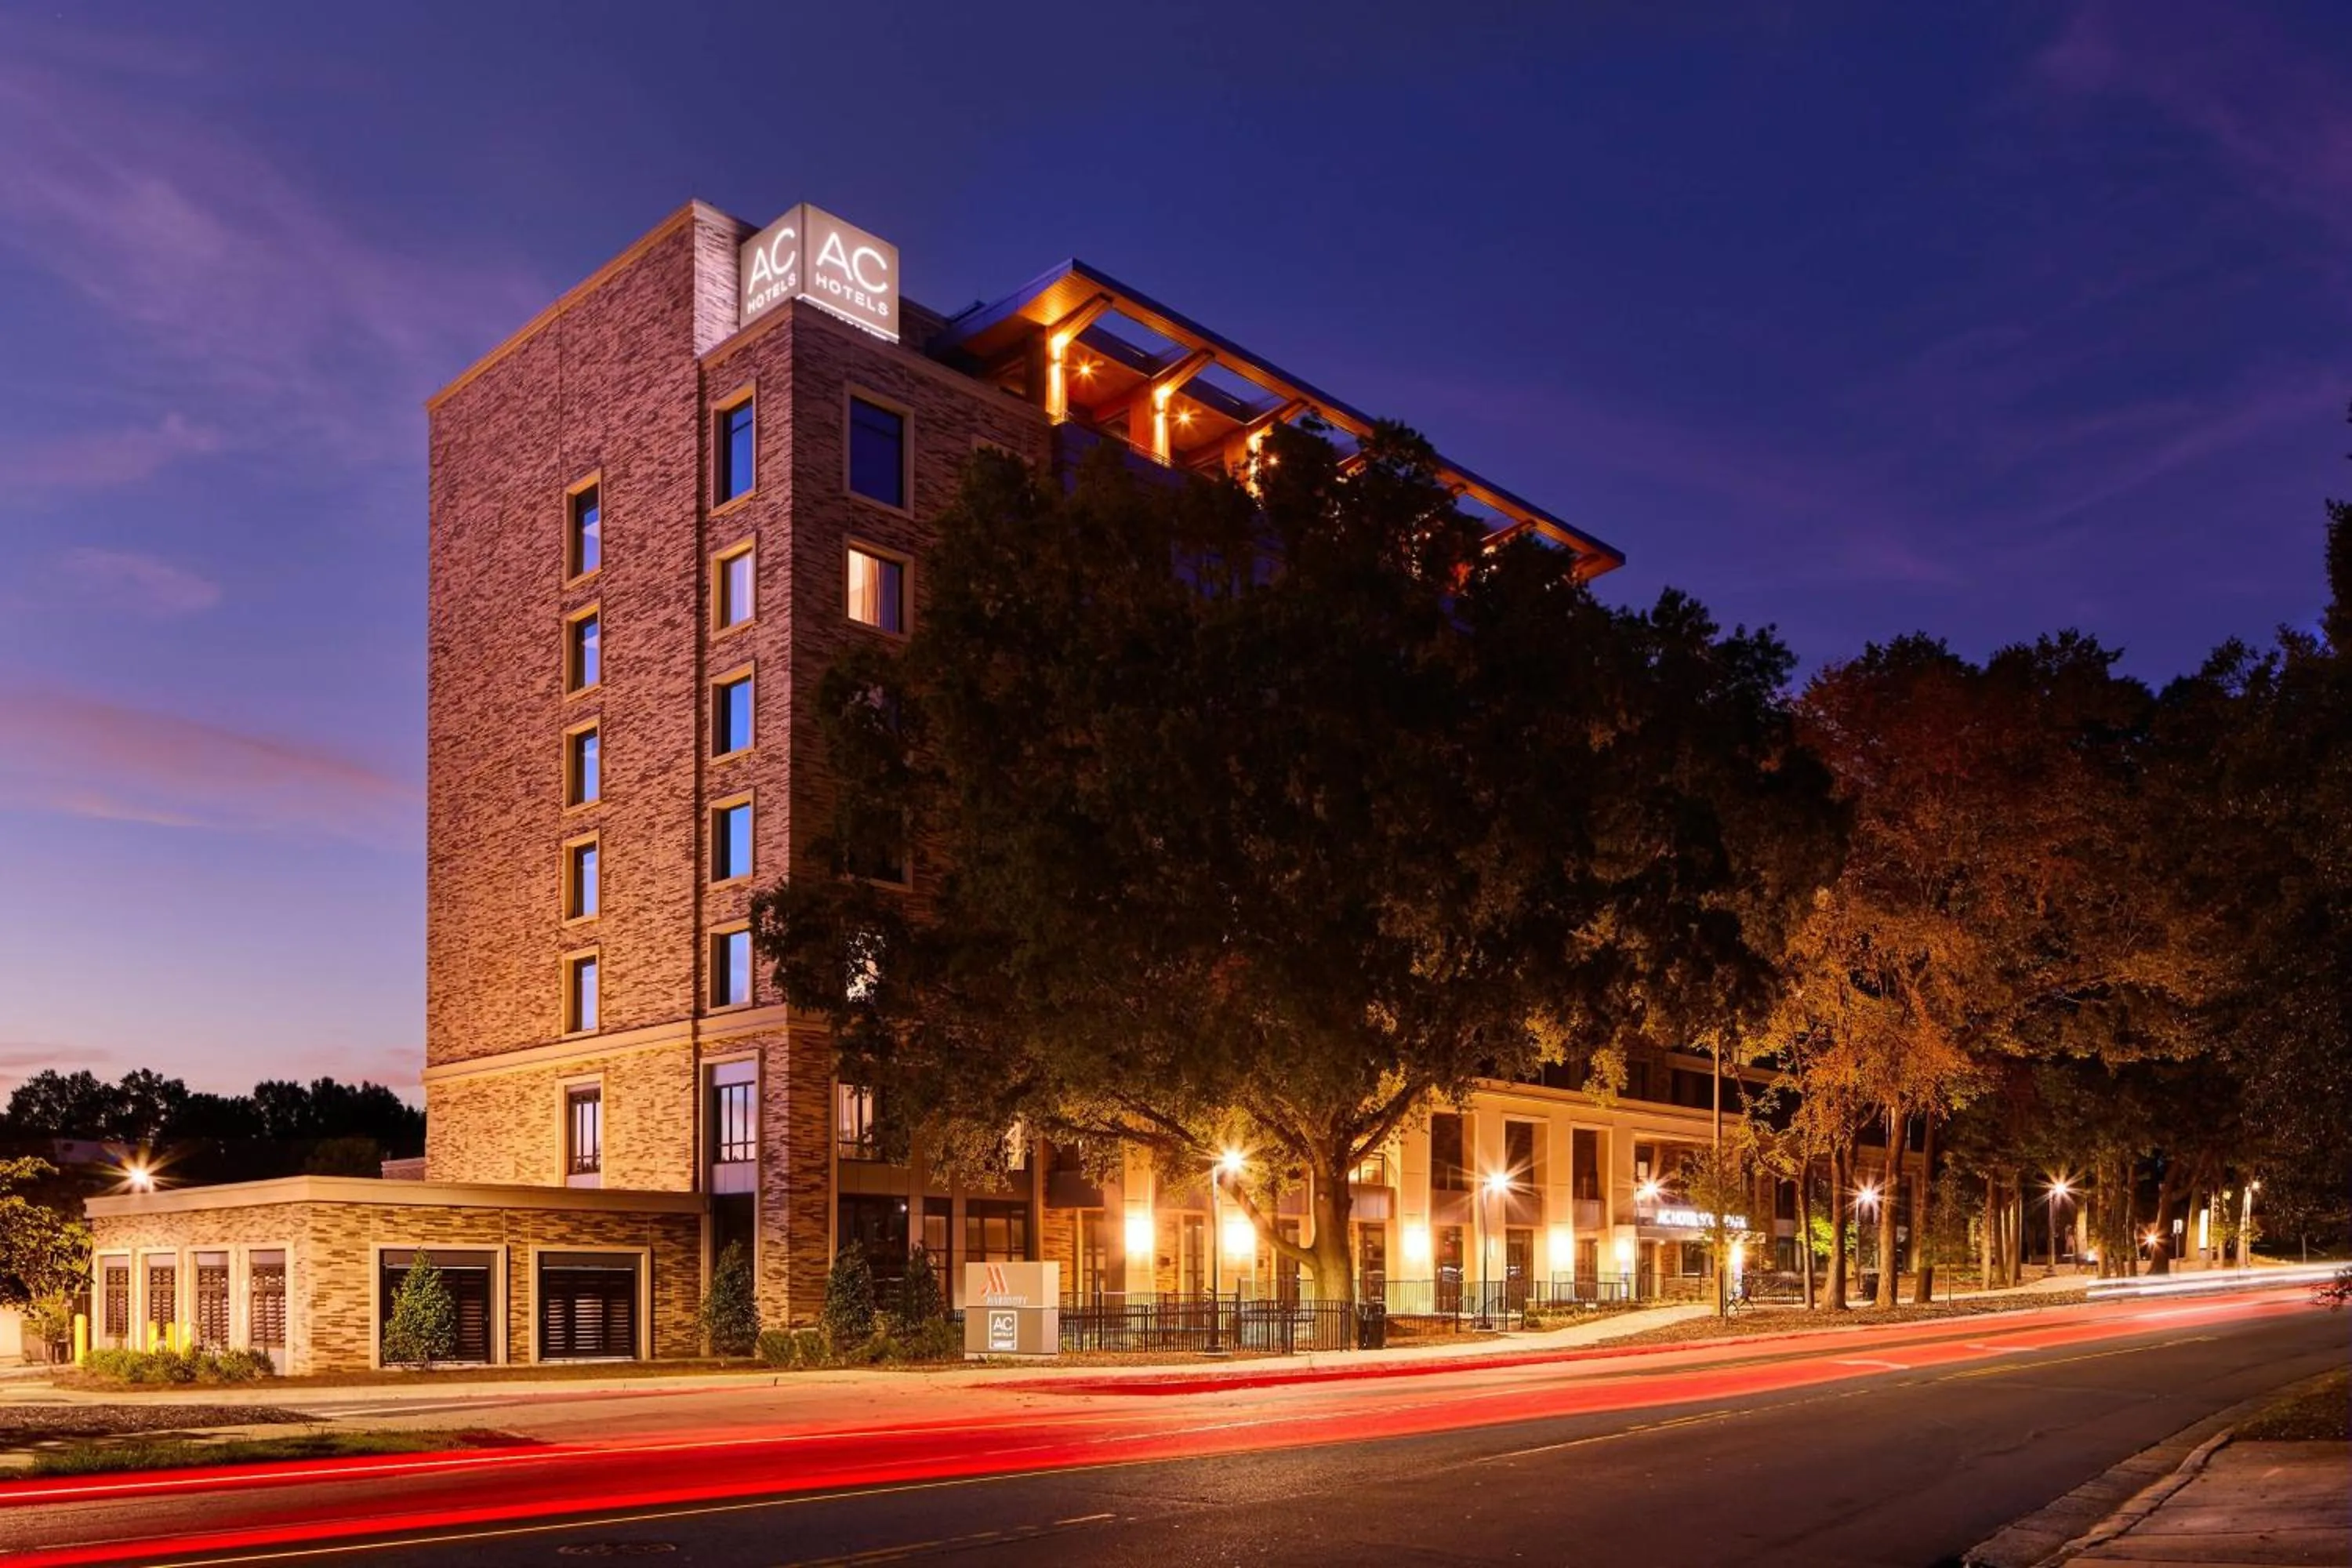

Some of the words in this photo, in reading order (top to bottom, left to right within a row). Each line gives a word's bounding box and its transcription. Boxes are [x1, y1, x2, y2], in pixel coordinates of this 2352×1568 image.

[748, 227, 796, 295] AC
[815, 232, 887, 293] AC
[747, 273, 796, 314] HOTELS
[815, 272, 889, 317] HOTELS
[993, 1317, 1013, 1330] AC
